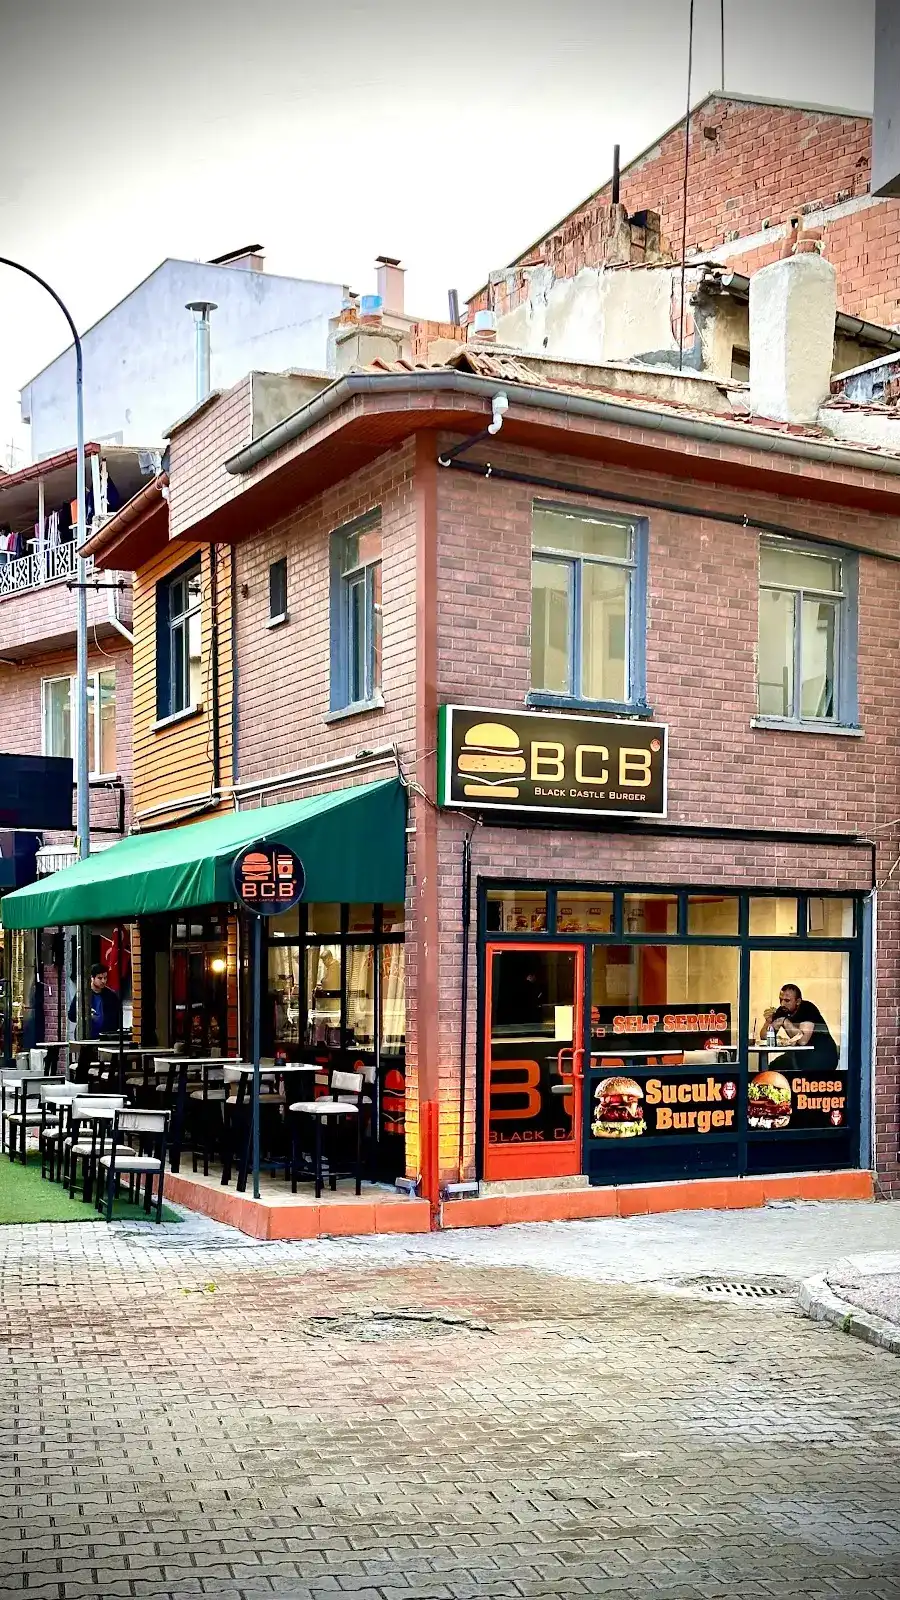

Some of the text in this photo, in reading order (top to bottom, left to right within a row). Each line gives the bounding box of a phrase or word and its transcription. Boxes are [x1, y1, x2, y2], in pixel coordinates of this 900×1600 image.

[531, 741, 652, 787] BCB
[534, 787, 646, 801] BLACK CASTLE BURGER
[242, 883, 294, 897] BCB
[613, 1015, 659, 1034] SELF
[645, 1077, 723, 1104] Sucuk
[792, 1077, 843, 1093] Cheese
[797, 1094, 846, 1113] Burger
[656, 1108, 735, 1133] Burger
